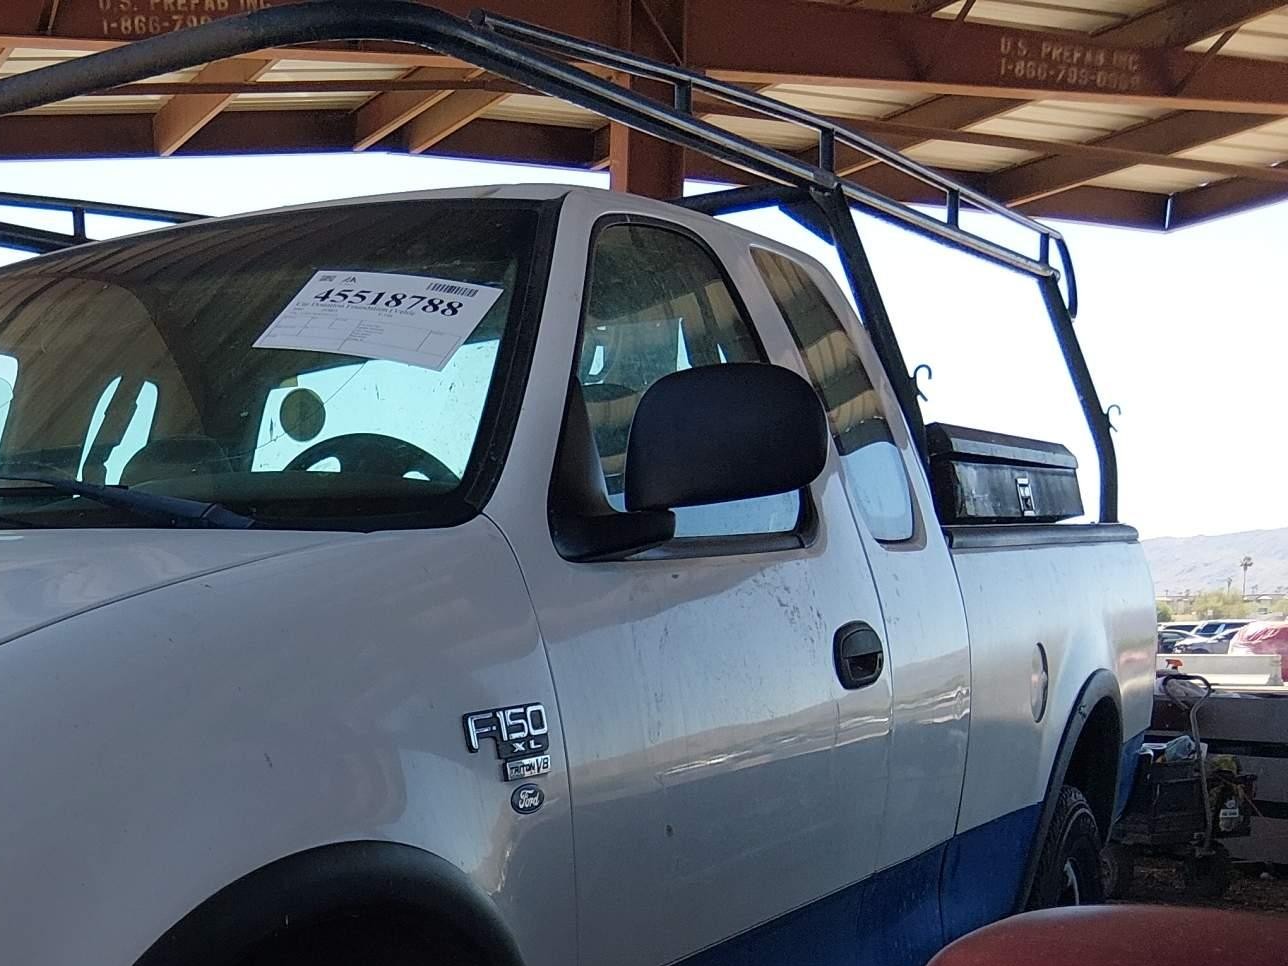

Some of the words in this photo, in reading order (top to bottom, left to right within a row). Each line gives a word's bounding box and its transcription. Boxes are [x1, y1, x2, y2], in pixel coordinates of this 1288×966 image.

[1000, 36, 1029, 57] U.S.
[1041, 41, 1105, 65] PREFAB
[314, 287, 464, 317] 45518788
[512, 740, 542, 753] XL
[535, 757, 550, 773] V8
[518, 789, 540, 809] Ford
